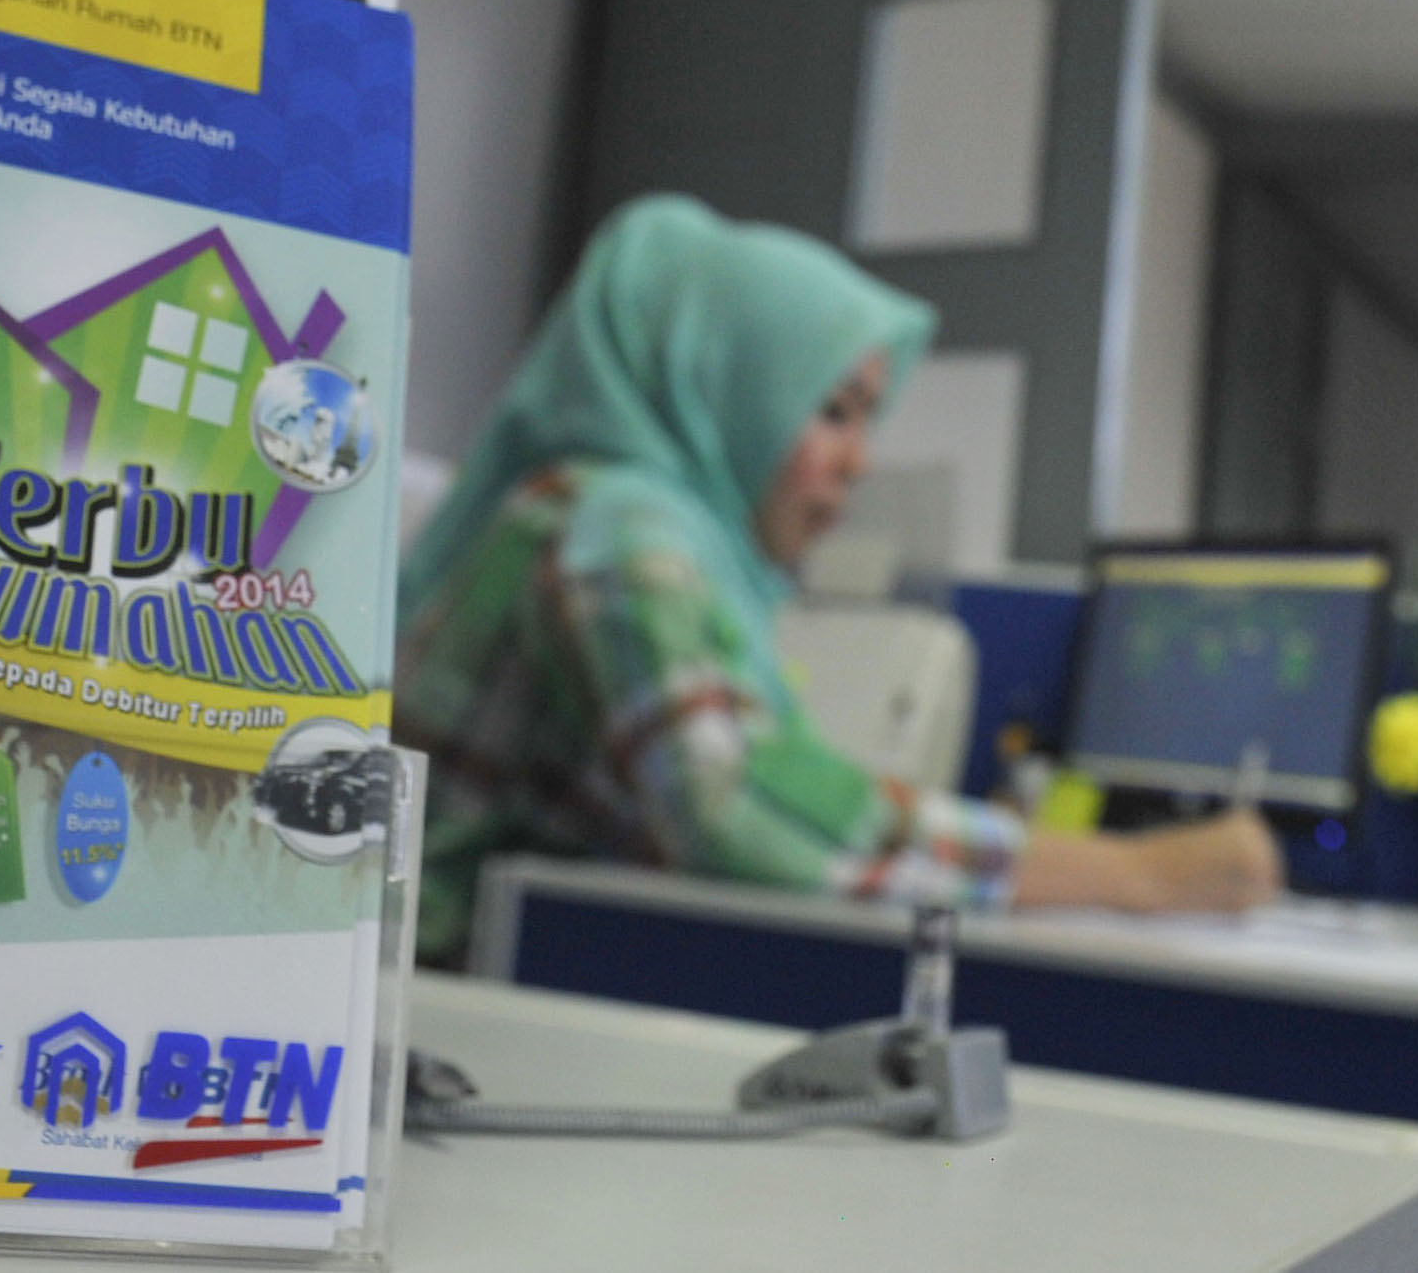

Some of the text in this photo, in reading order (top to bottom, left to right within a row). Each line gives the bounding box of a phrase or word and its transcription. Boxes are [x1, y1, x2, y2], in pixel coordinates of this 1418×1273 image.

[169, 18, 224, 53] BTN
[12, 76, 97, 123] Segala
[103, 98, 237, 151] Kebutuhan
[212, 571, 316, 613] 2014
[79, 679, 182, 724] Debitur
[186, 699, 287, 734] Terpilih
[65, 811, 121, 836] Bunga
[136, 1030, 345, 1132] BTN
[40, 1129, 110, 1151] Sahabat
